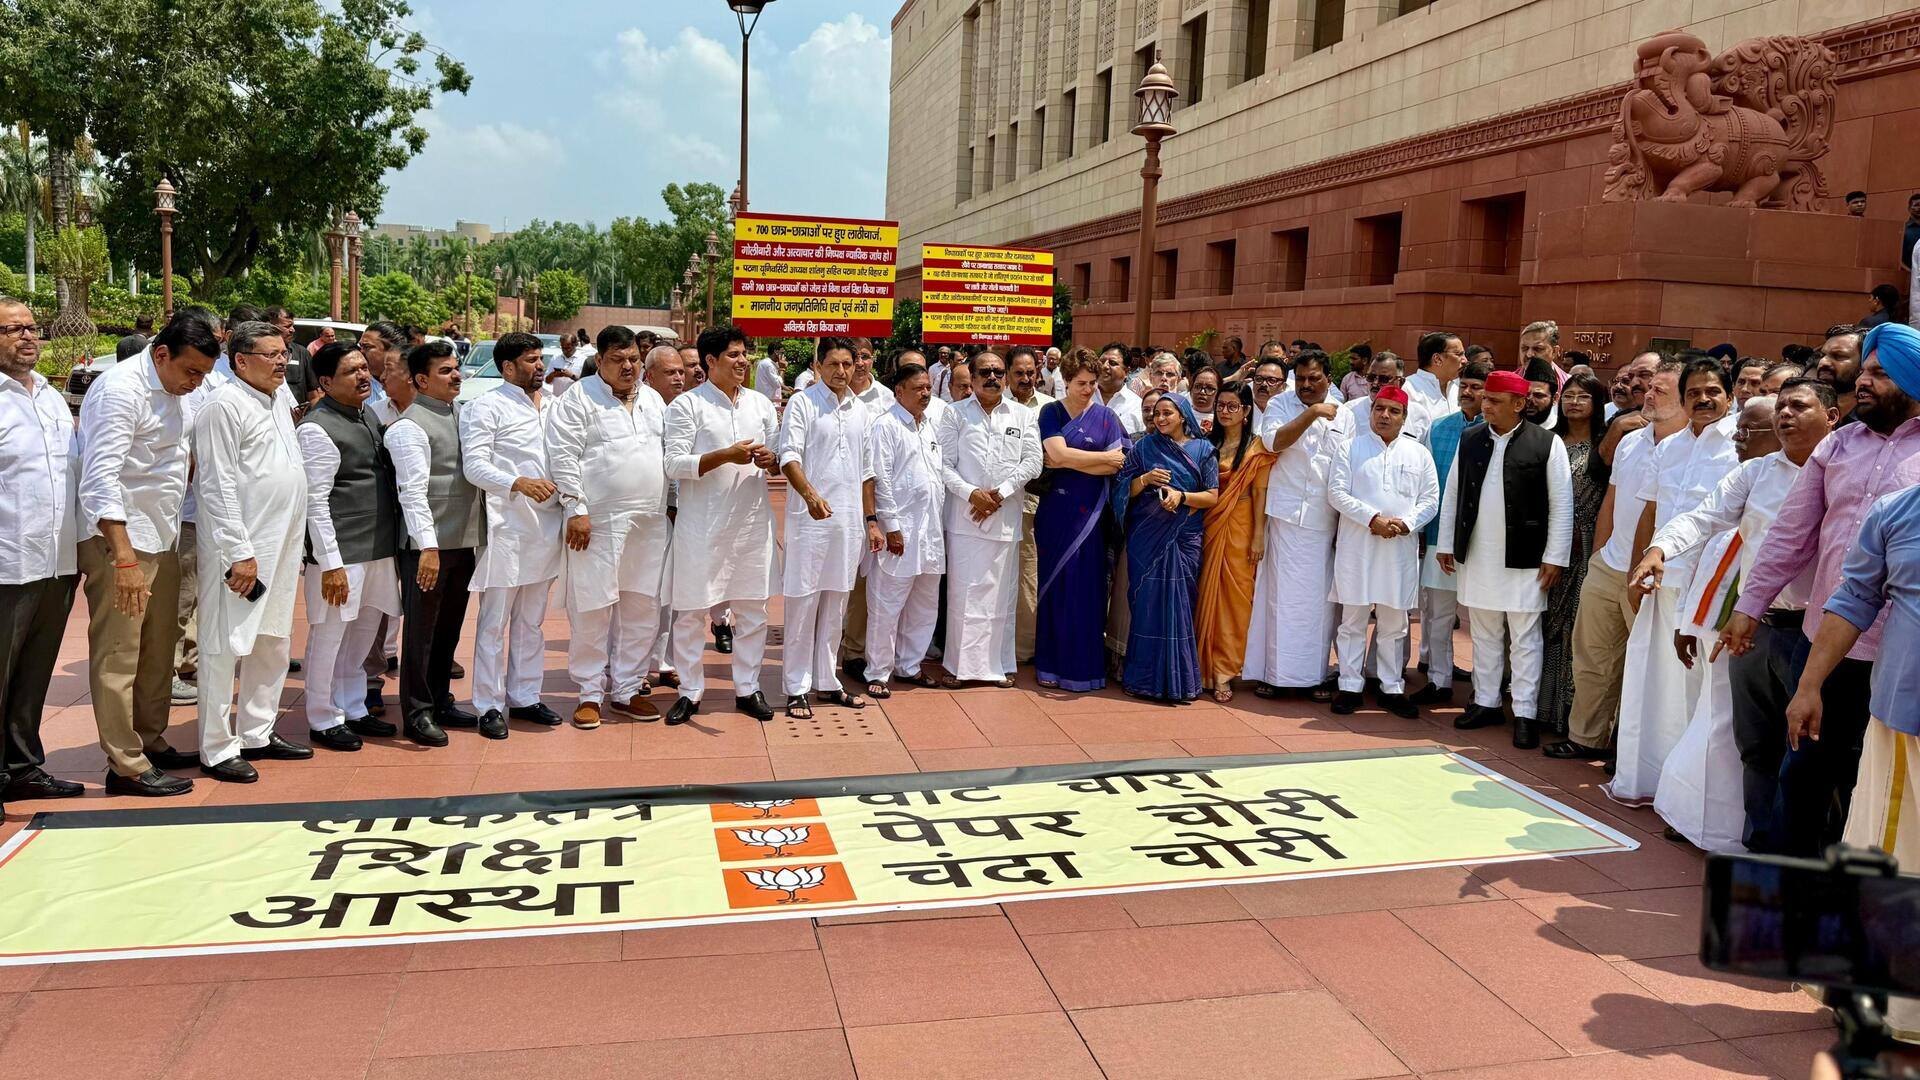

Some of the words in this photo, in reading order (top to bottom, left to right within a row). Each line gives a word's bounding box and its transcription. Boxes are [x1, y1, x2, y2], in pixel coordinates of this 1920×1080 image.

[756, 225, 768, 234] 700
[771, 225, 821, 237] छात्र-छात्राओं
[822, 229, 833, 239] पर
[835, 228, 846, 243] हुए
[741, 244, 771, 256] गोलीबारी
[773, 245, 785, 257] और
[787, 249, 814, 258] अत्याचार
[815, 247, 824, 258] की
[825, 248, 845, 259] निष्पक्ष
[846, 249, 868, 260] न्यायिक
[827, 267, 841, 275] सहित
[857, 267, 867, 276] और
[868, 269, 882, 277] बिहार
[883, 268, 888, 276] के
[741, 280, 755, 291] सभी
[756, 283, 764, 291] 700
[801, 282, 809, 291] को
[810, 282, 821, 292] जेल
[822, 283, 827, 293] से
[751, 298, 781, 311] माननीय
[784, 297, 827, 313] जनप्रतिनिधि
[829, 300, 841, 313] एवं
[842, 300, 853, 317] पूर्व
[854, 298, 867, 313] मंत्री
[870, 300, 879, 313] को
[784, 320, 805, 332] अविलंब
[807, 321, 818, 332] रिहा
[819, 321, 834, 332] किया
[308, 837, 638, 881] शिक्षा
[862, 811, 1087, 847] पेपर
[1136, 788, 1357, 829] चोरी
[229, 879, 635, 929] आस्था
[881, 852, 1083, 888] चंदा
[1131, 826, 1347, 869] चोरी
